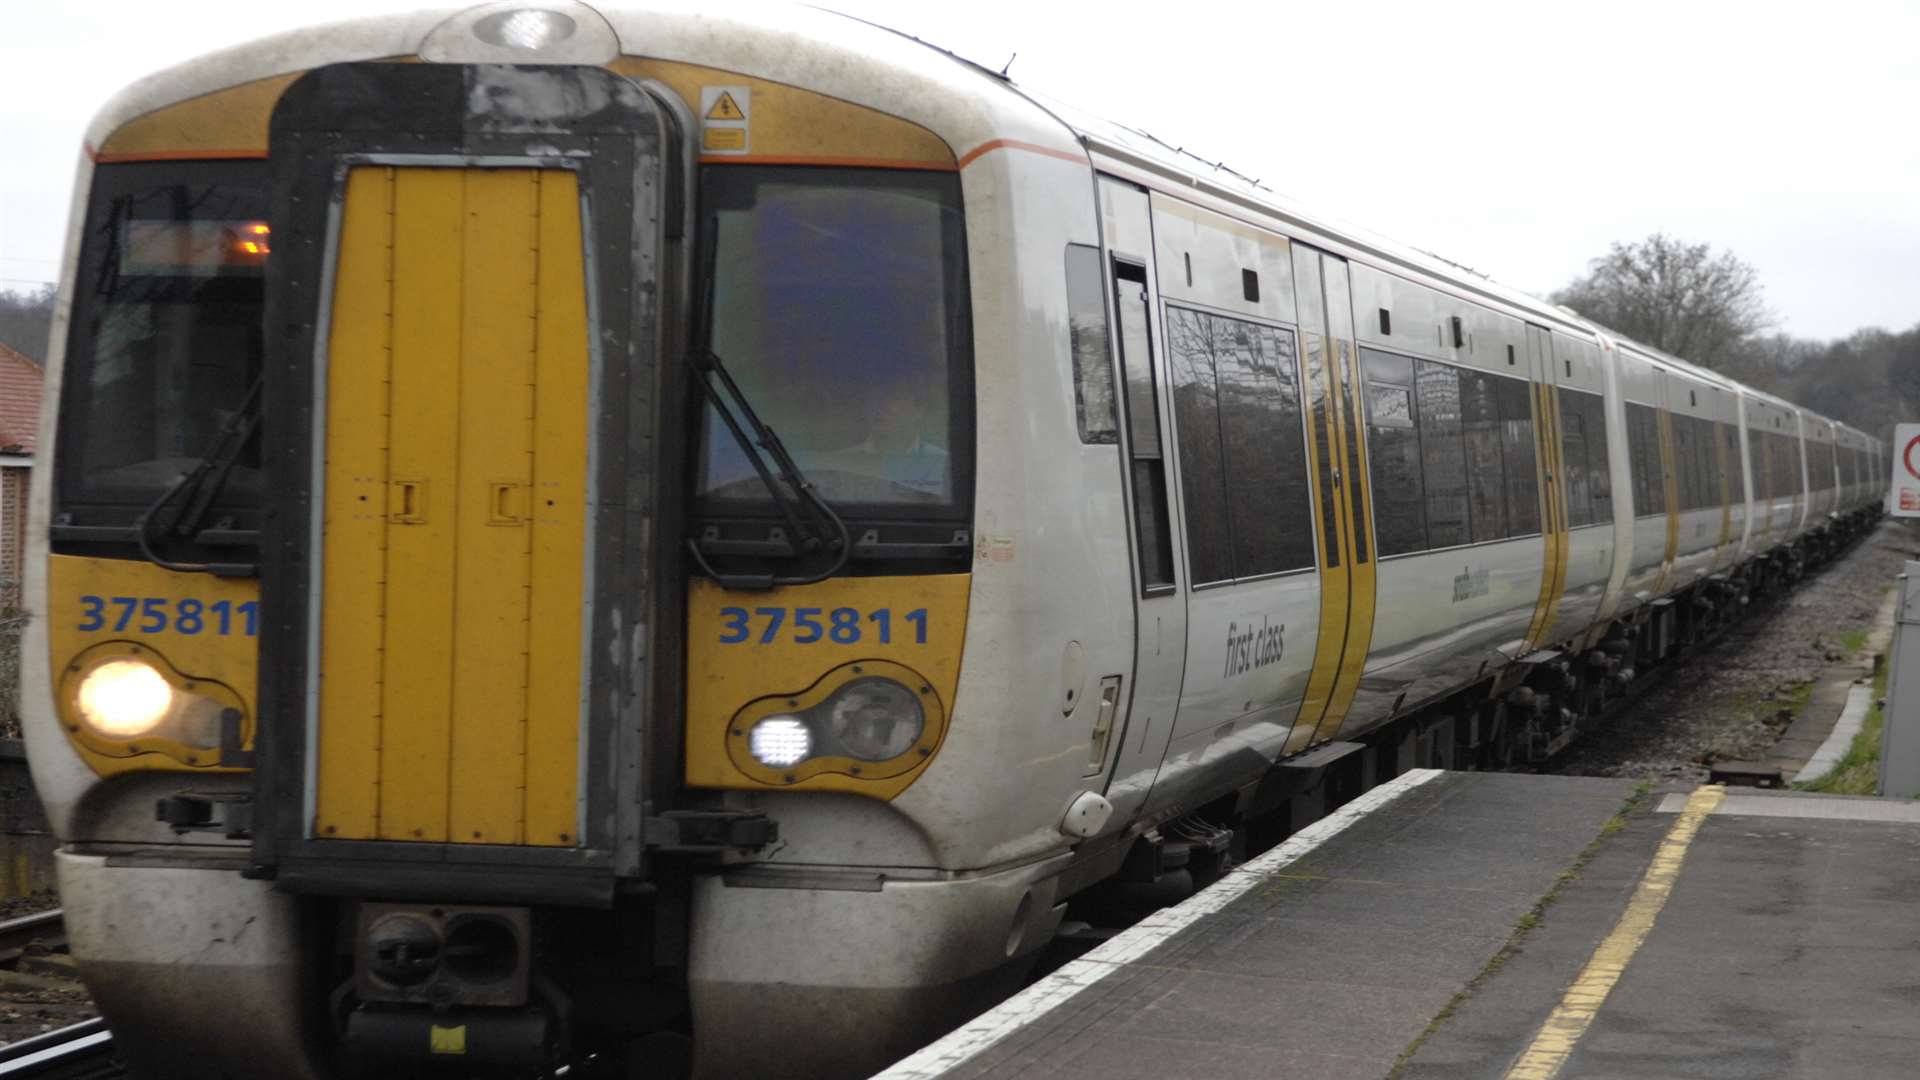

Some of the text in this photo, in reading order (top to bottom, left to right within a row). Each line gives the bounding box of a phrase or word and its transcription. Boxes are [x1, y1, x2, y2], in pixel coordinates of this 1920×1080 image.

[78, 595, 258, 636] 375811
[719, 607, 928, 645] 375811
[1223, 615, 1285, 679] first class
